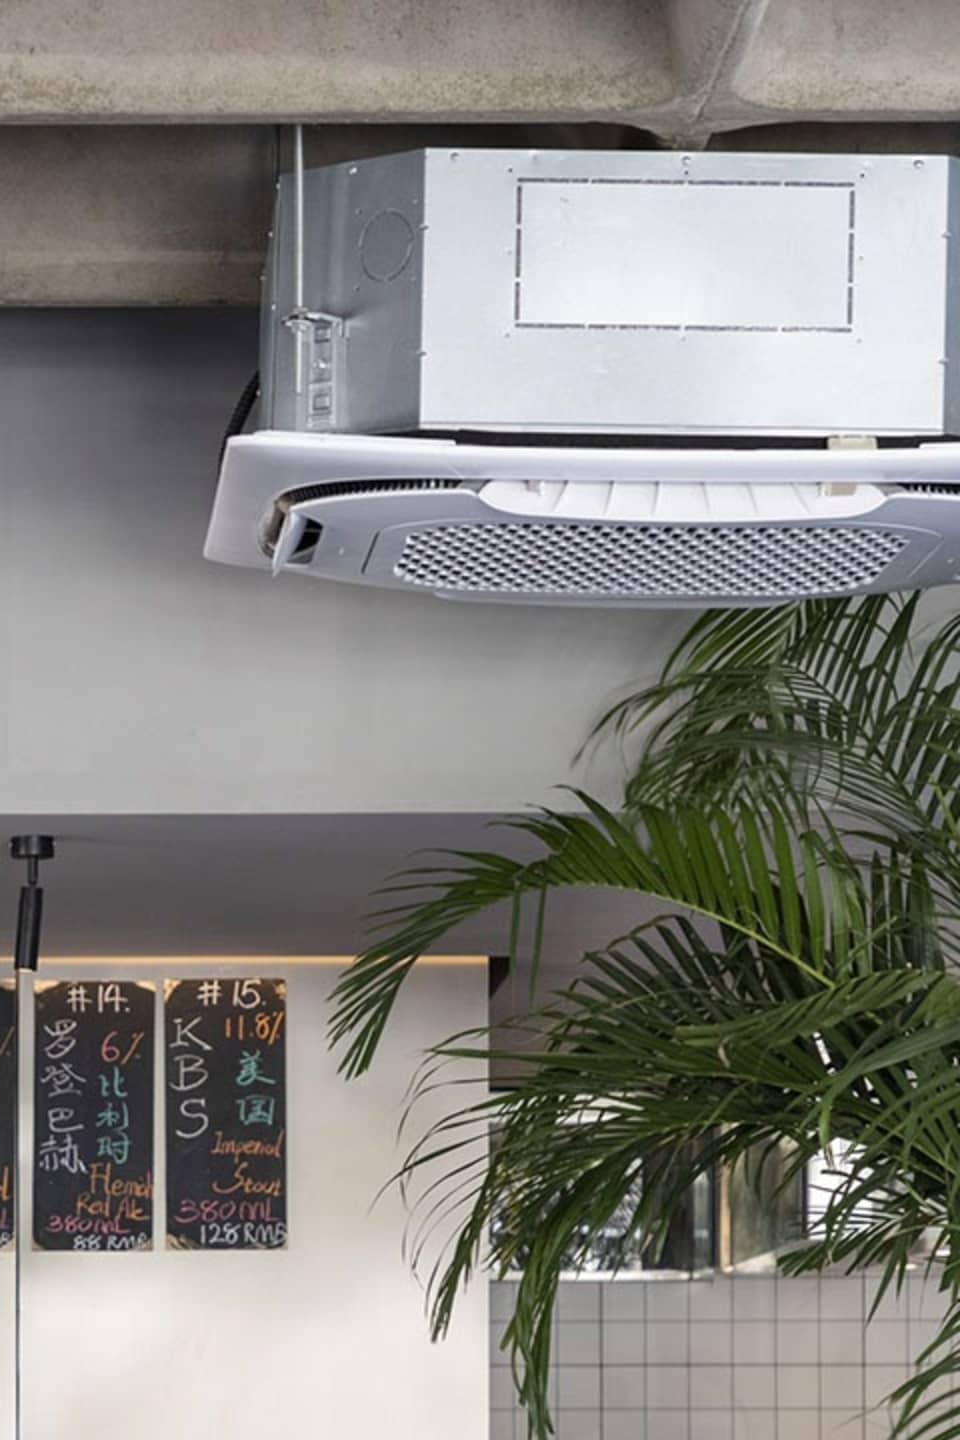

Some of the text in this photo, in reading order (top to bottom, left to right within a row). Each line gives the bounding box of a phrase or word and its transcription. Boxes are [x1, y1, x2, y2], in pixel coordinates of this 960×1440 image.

[100, 1031, 145, 1064] 6%
[95, 1065, 131, 1165] 比利时
[235, 1050, 276, 1126] 美国
